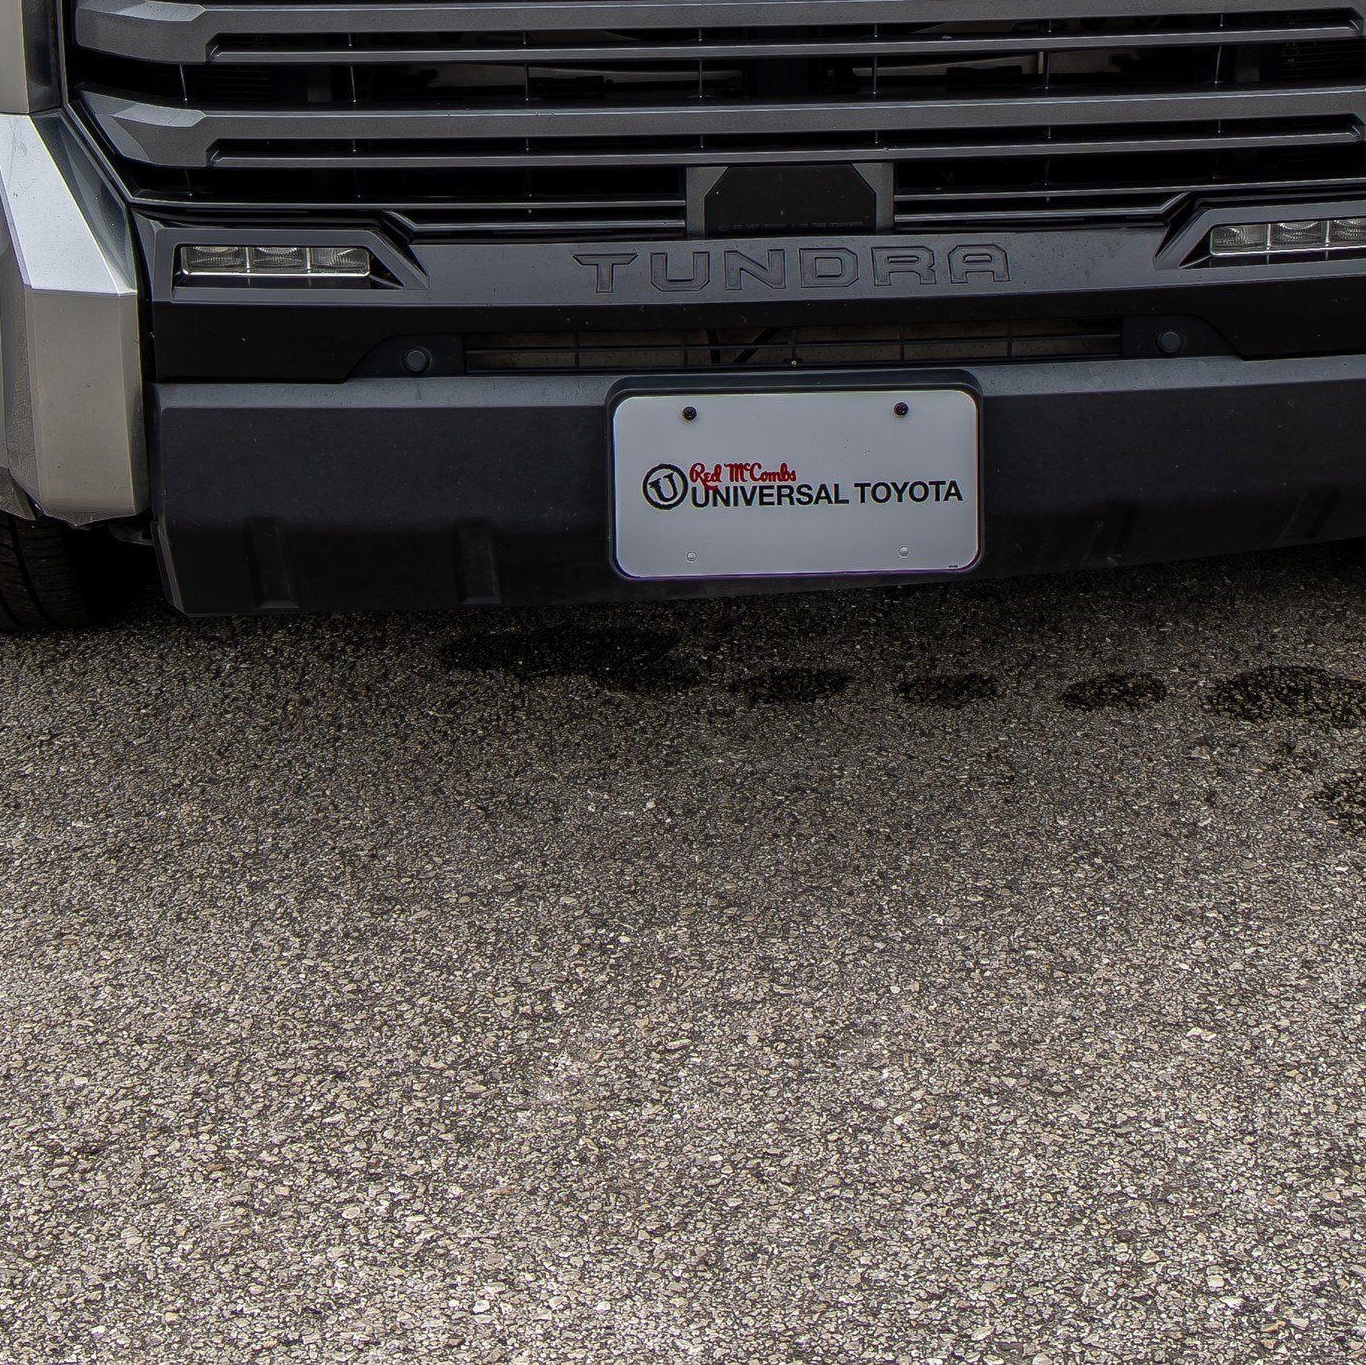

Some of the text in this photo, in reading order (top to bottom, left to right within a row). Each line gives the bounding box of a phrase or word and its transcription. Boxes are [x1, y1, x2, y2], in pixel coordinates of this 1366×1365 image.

[572, 243, 1012, 294] TUNDRA
[689, 462, 797, 490] Red McCombs
[691, 480, 964, 508] UNIVERSAL TOYOTA
